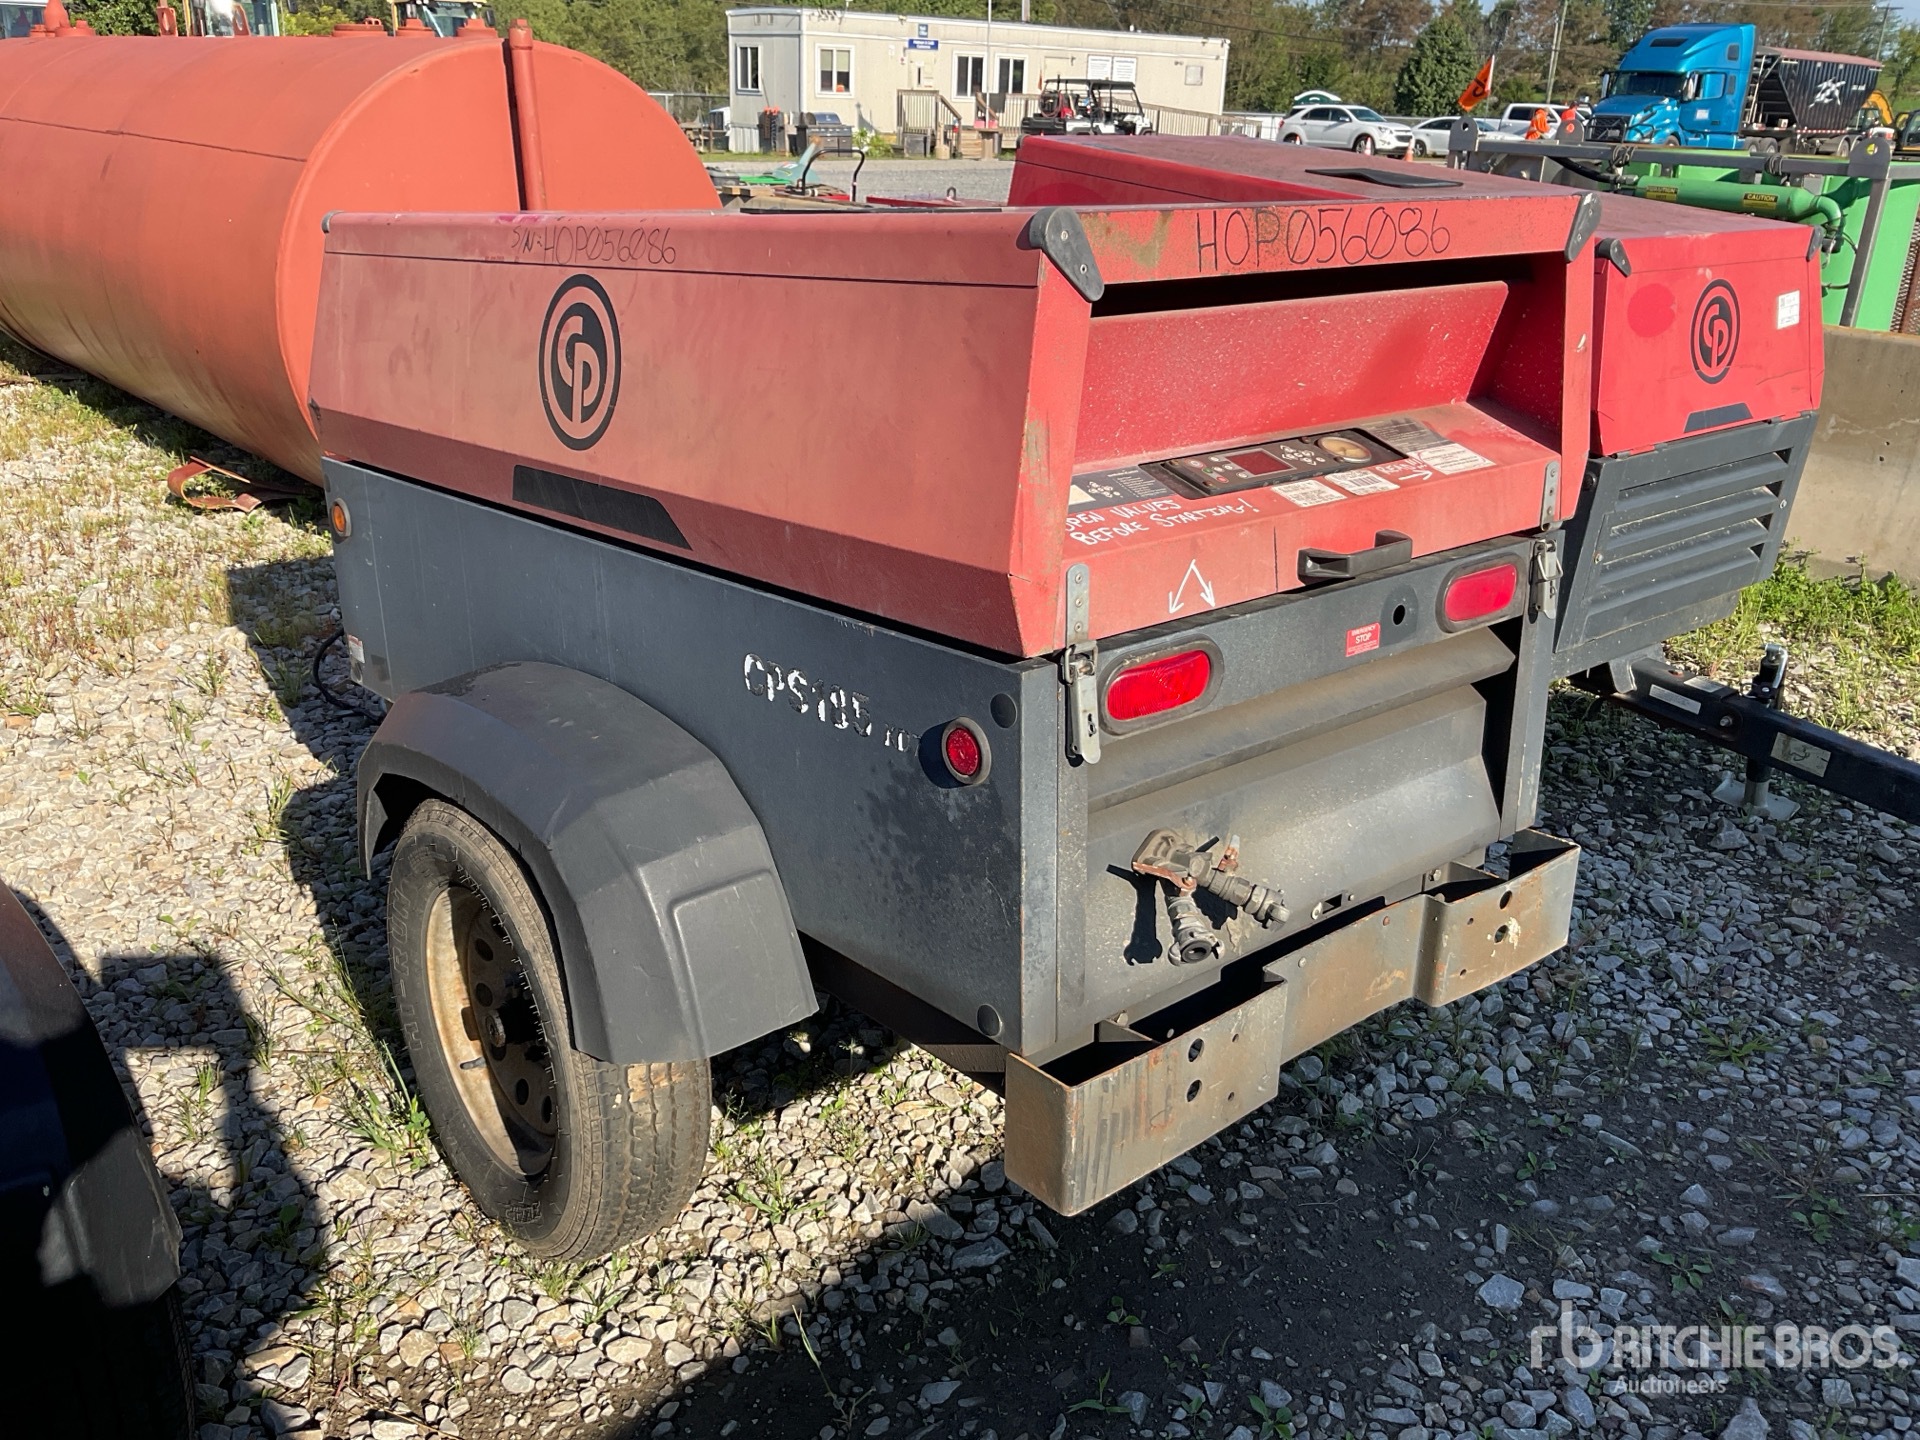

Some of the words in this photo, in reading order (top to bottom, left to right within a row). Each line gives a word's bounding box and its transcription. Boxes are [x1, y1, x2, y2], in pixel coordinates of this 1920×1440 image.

[1746, 192, 1776, 202] CAUTION
[1196, 206, 1451, 273] HOP056086
[1109, 499, 1182, 520] VALVES
[1069, 521, 1150, 546] BEFORE
[1355, 632, 1372, 645] STOP
